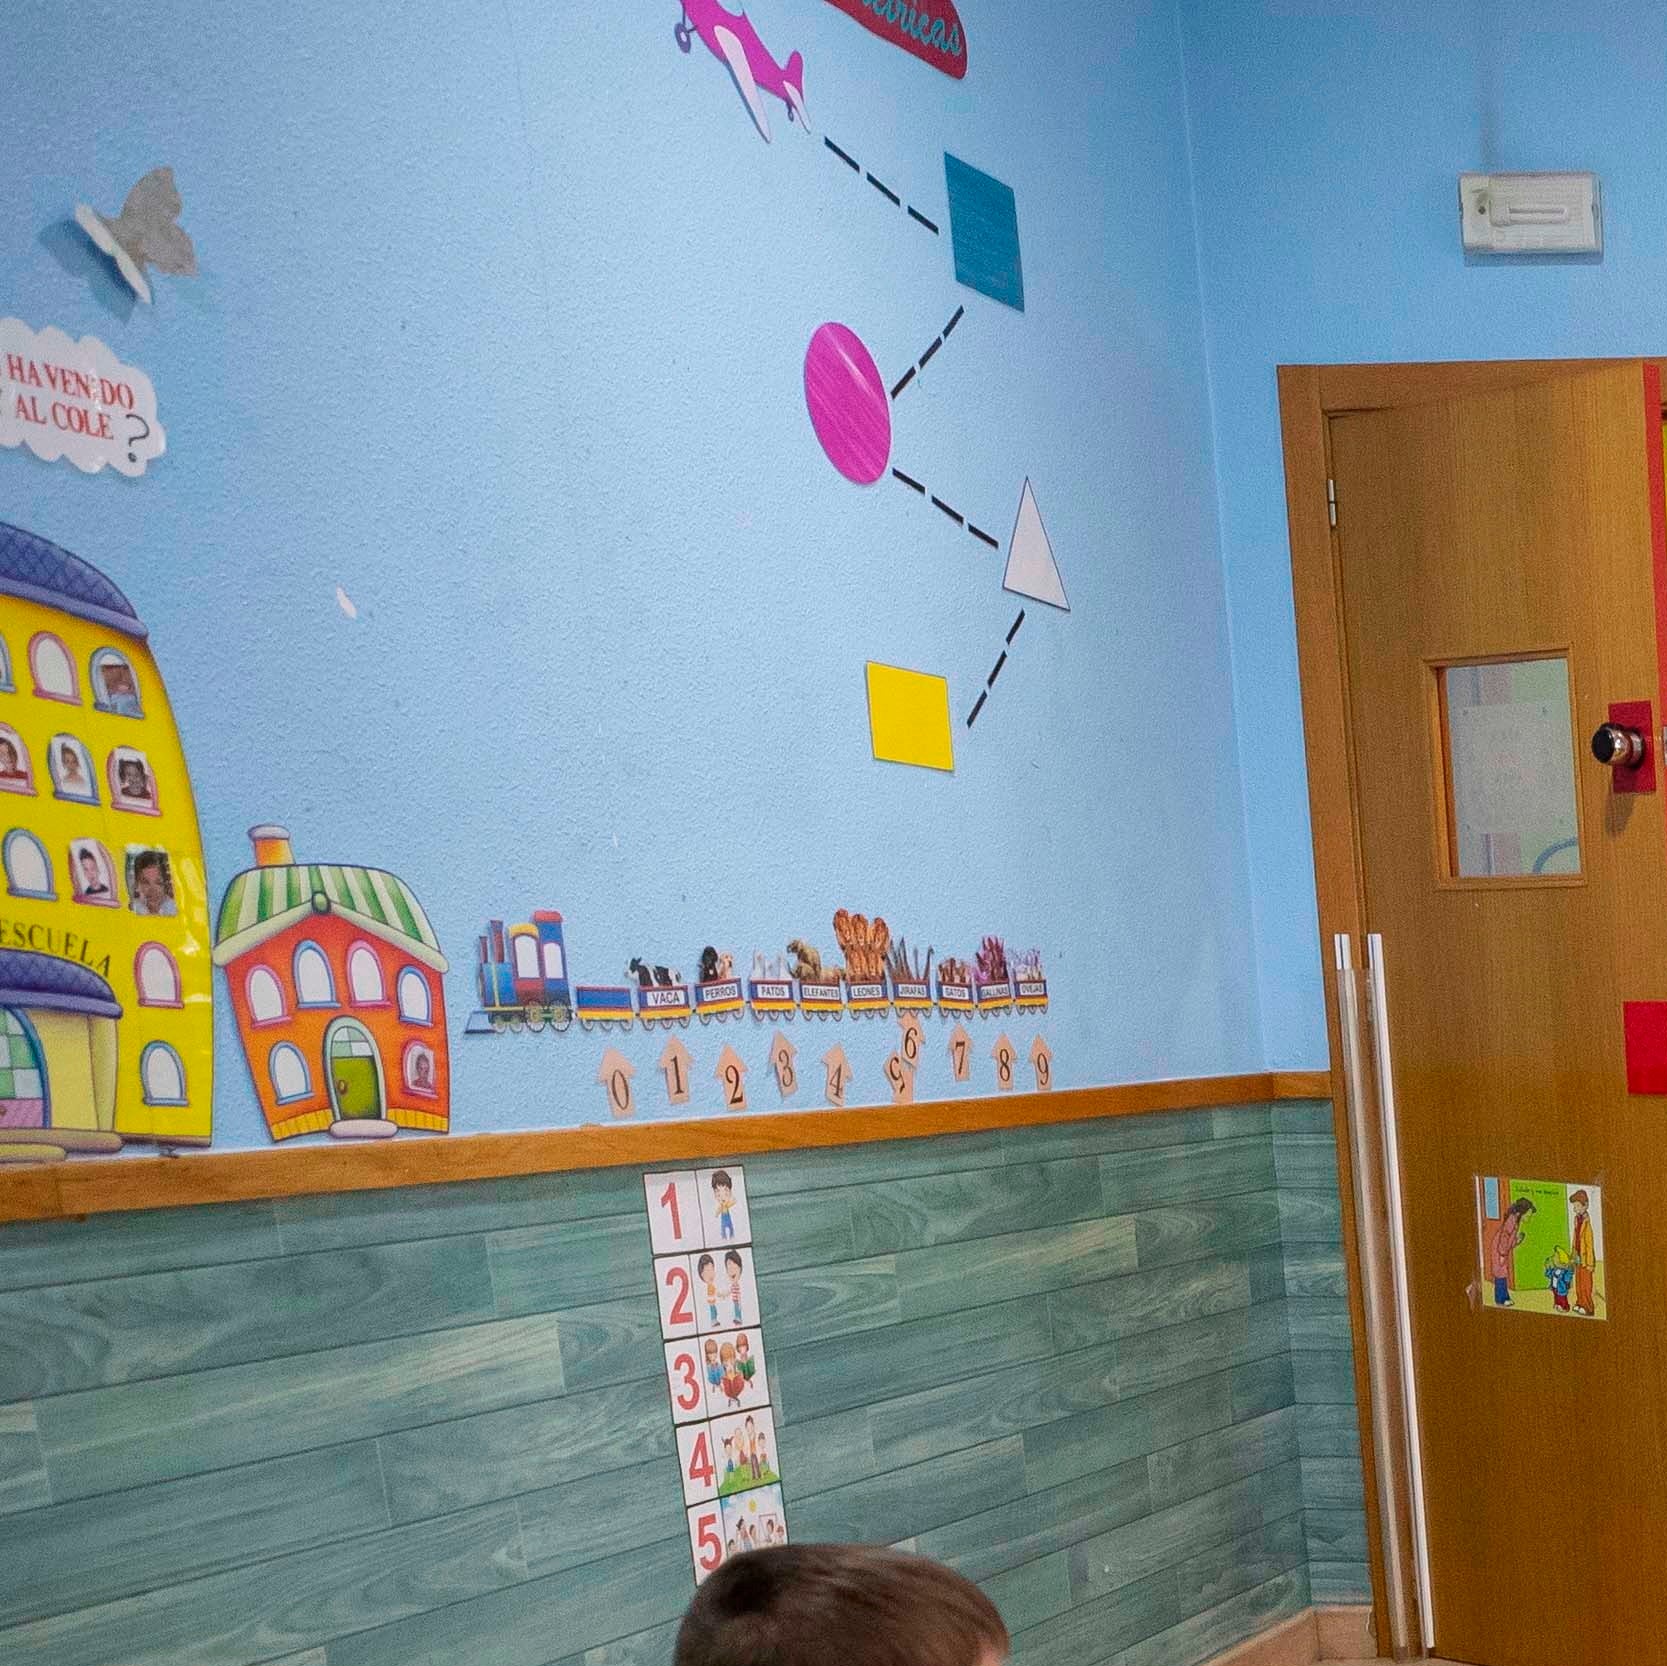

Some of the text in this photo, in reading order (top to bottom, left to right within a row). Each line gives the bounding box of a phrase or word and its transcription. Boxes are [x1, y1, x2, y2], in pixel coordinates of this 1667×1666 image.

[7, 353, 43, 388] HA
[16, 393, 47, 424] AL
[653, 991, 680, 1004] VACA
[705, 984, 736, 999] PERROS
[761, 986, 785, 997] PATOS
[803, 987, 839, 998] ELEFANTES
[853, 986, 880, 997] LEONES
[904, 1026, 918, 1060] 6
[955, 1040, 966, 1075] 7
[670, 1055, 685, 1095] 1
[778, 1049, 794, 1087] 3
[829, 1063, 843, 1098] 4
[999, 1049, 1011, 1082] 8
[1037, 1053, 1049, 1085] 9
[725, 1064, 744, 1104] 2
[660, 1182, 684, 1240] 1
[665, 1266, 694, 1326] 2
[673, 1352, 701, 1411] 3
[688, 1431, 716, 1487] 4
[697, 1512, 724, 1573] 5
